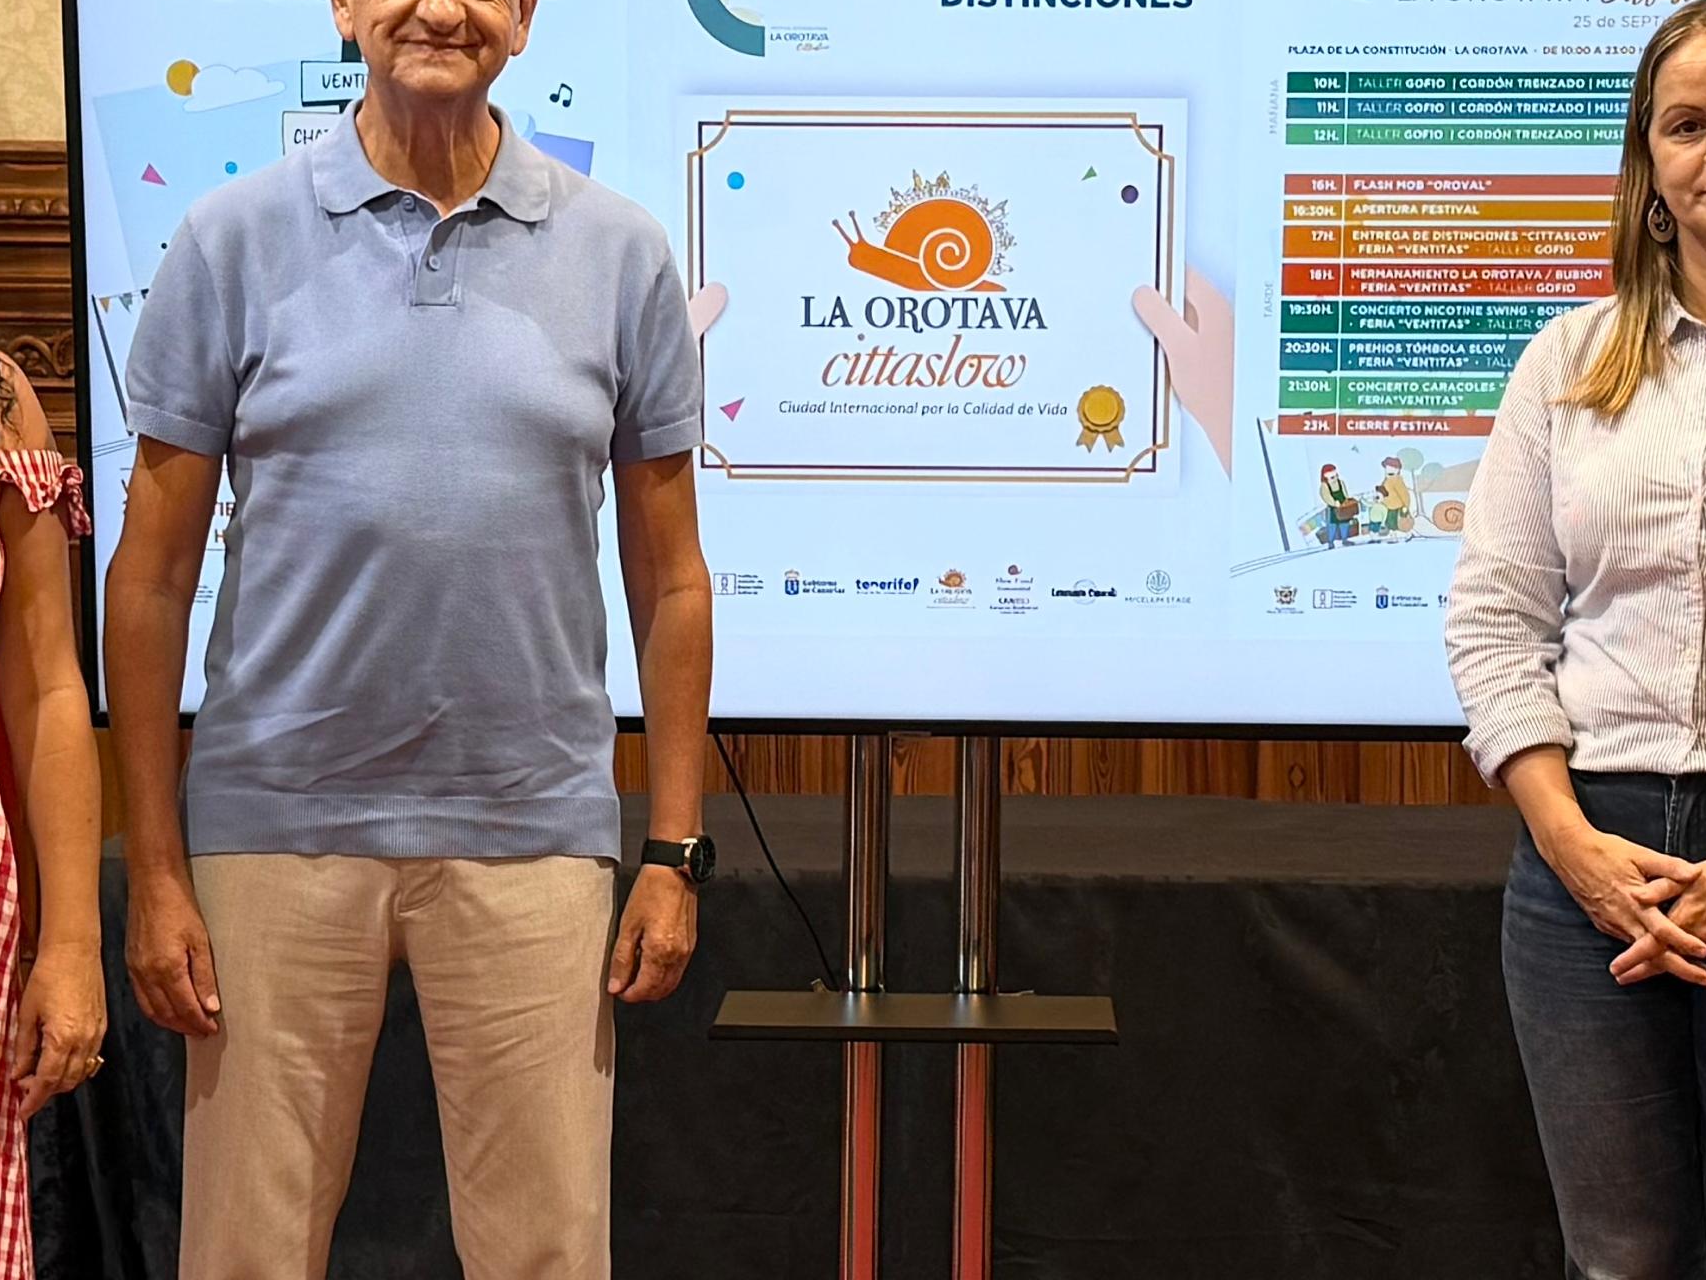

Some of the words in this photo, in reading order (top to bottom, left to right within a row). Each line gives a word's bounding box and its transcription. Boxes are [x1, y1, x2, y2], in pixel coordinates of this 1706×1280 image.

[1573, 15, 1592, 29] 25
[1596, 15, 1616, 29] de
[321, 72, 365, 90] VENTI
[1405, 78, 1446, 90] GOFIO
[1459, 75, 1514, 90] CORDÓN
[1517, 77, 1585, 90] TRENZADO
[1353, 179, 1393, 191] FLASH
[1396, 179, 1425, 191] MOB
[1352, 204, 1419, 216] APERTURA
[1421, 204, 1480, 216] FESTIVAL
[1352, 230, 1409, 242] ENTREGA
[1412, 230, 1430, 242] DE
[1432, 230, 1519, 242] DISTINCIONES
[800, 295, 853, 328] LA
[864, 296, 1048, 333] OROTAVA
[821, 332, 1027, 388] cittaslow
[778, 400, 827, 414] Ciudad
[829, 401, 919, 414] Internacional
[921, 405, 944, 417] por
[947, 402, 959, 415] la
[963, 401, 1015, 415] Calidad
[1017, 402, 1034, 416] de
[1037, 402, 1068, 416] Vida
[1345, 421, 1390, 432] CIERRE
[1392, 421, 1450, 432] FESTIVAL
